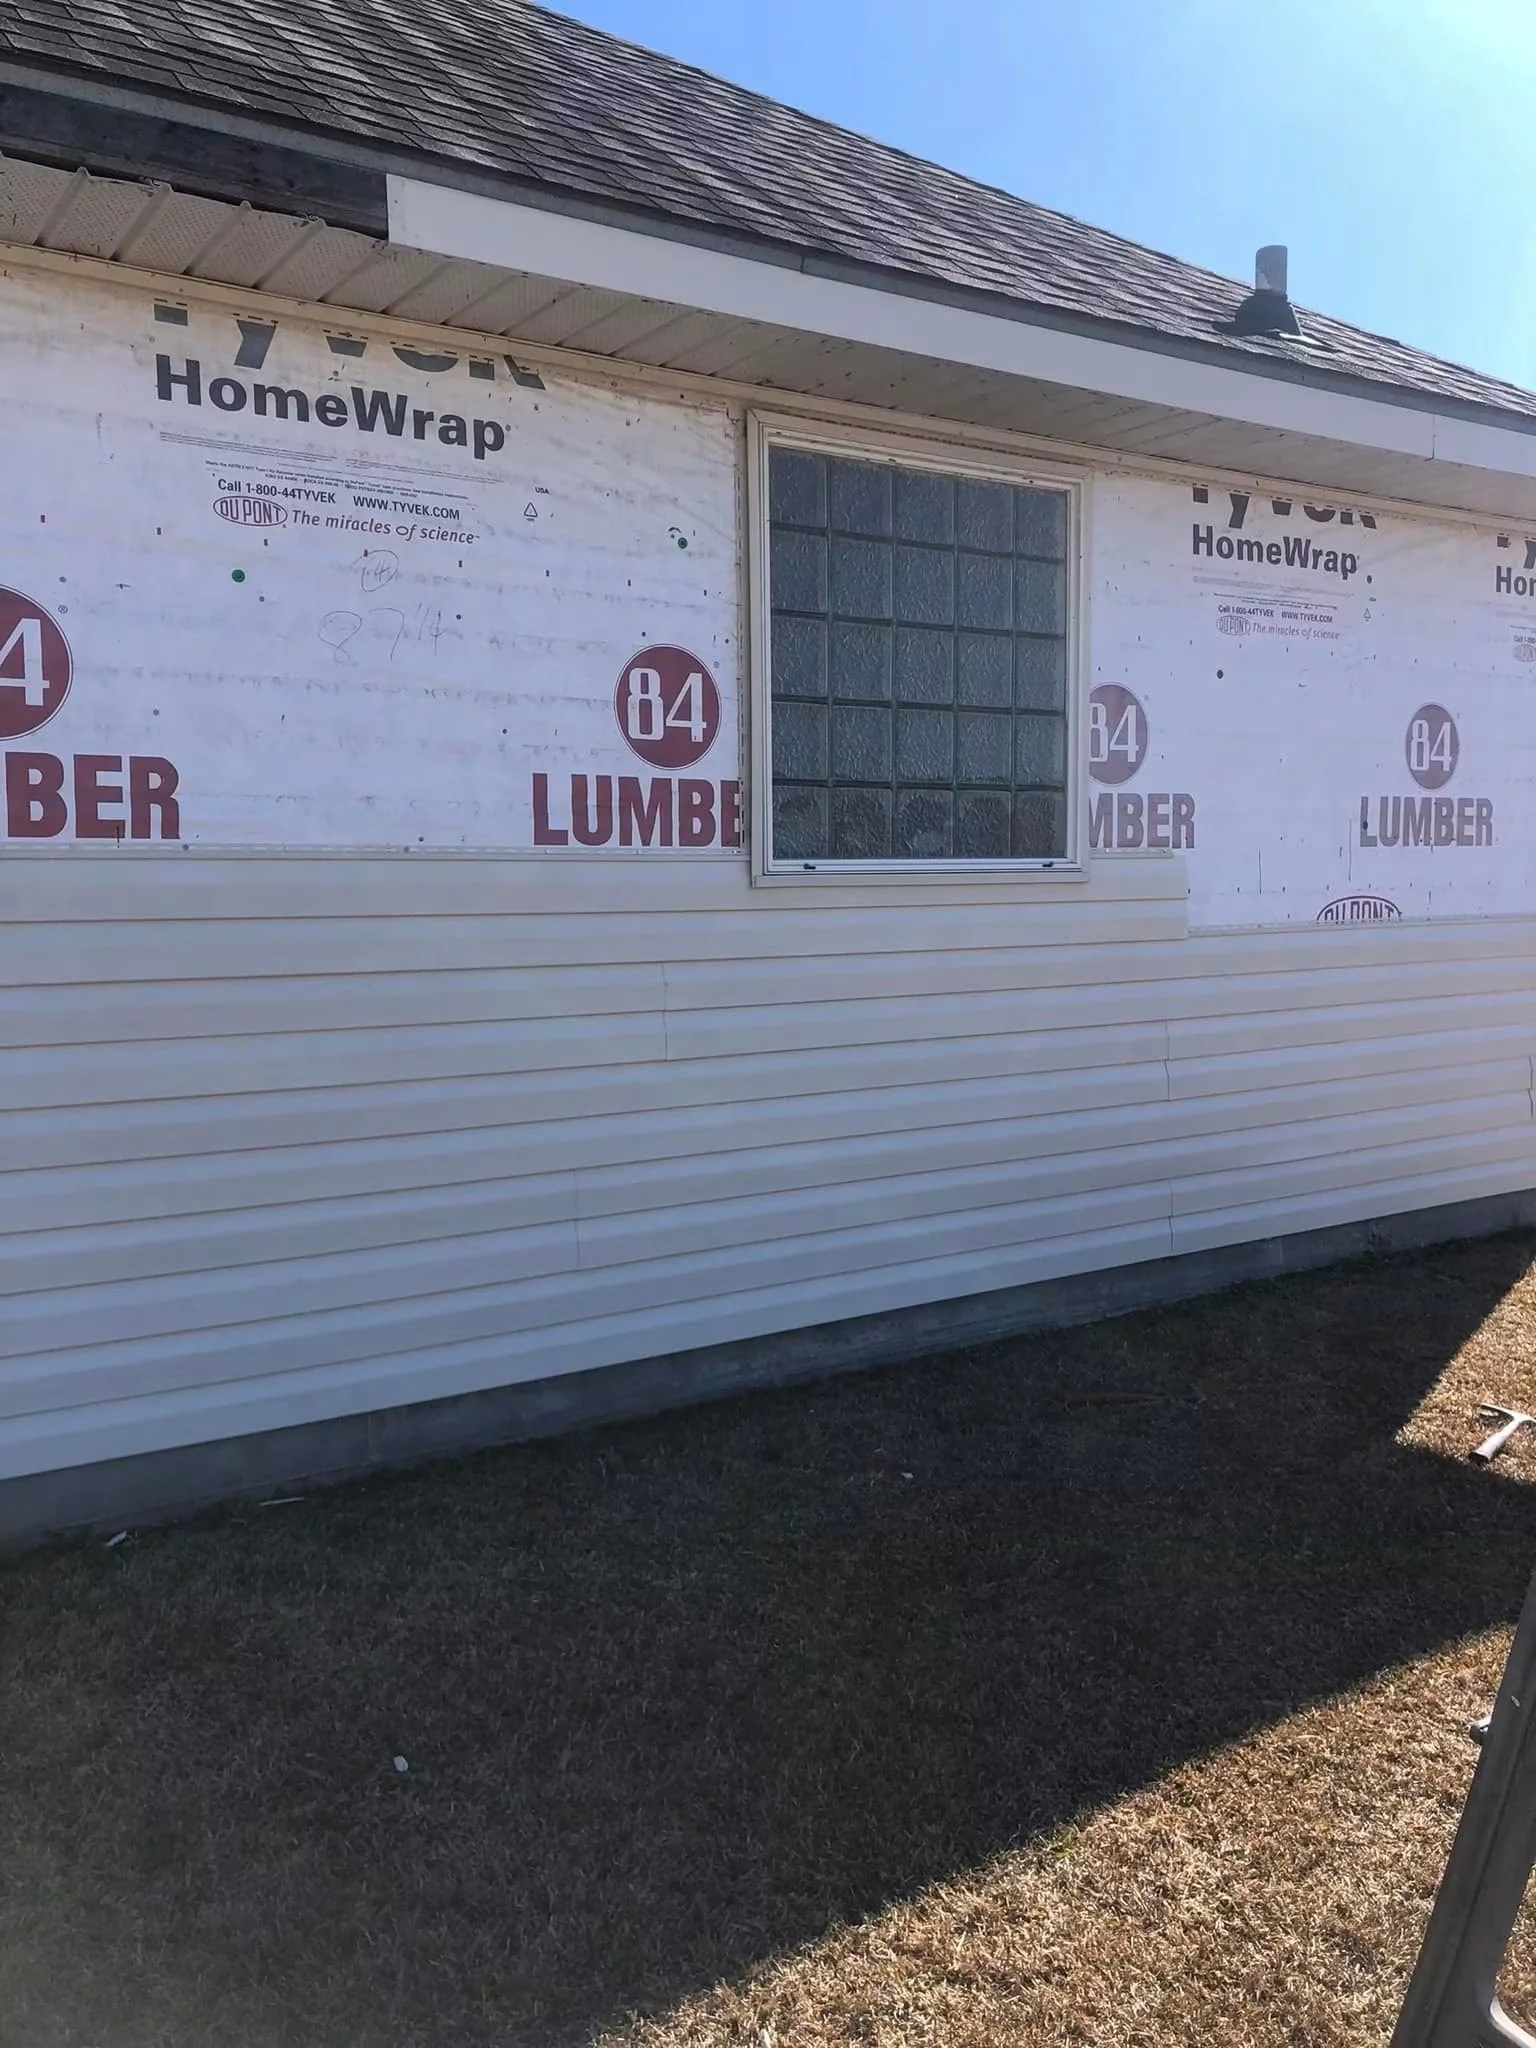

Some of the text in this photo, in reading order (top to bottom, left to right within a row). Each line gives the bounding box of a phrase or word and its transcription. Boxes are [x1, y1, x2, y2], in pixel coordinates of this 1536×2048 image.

[156, 354, 505, 460] HomeWrap
[218, 479, 241, 493] Call
[245, 482, 337, 504] 1-800-44TYVEK
[353, 495, 460, 521] WWW.TYVEK.COM
[292, 509, 320, 526] The
[325, 514, 391, 535] miracles
[395, 523, 417, 541] of
[420, 526, 474, 544] science
[1192, 523, 1357, 580] HomeWrap
[1495, 565, 1536, 597] Ho
[1218, 605, 1230, 614] Call
[1252, 622, 1267, 633] The
[1268, 624, 1300, 637] miracles
[1301, 629, 1312, 640] of
[1312, 629, 1340, 640] science
[627, 667, 707, 743] 84
[1410, 719, 1452, 771] 84
[5, 751, 181, 840] BER
[1359, 796, 1494, 847] LUMBER
